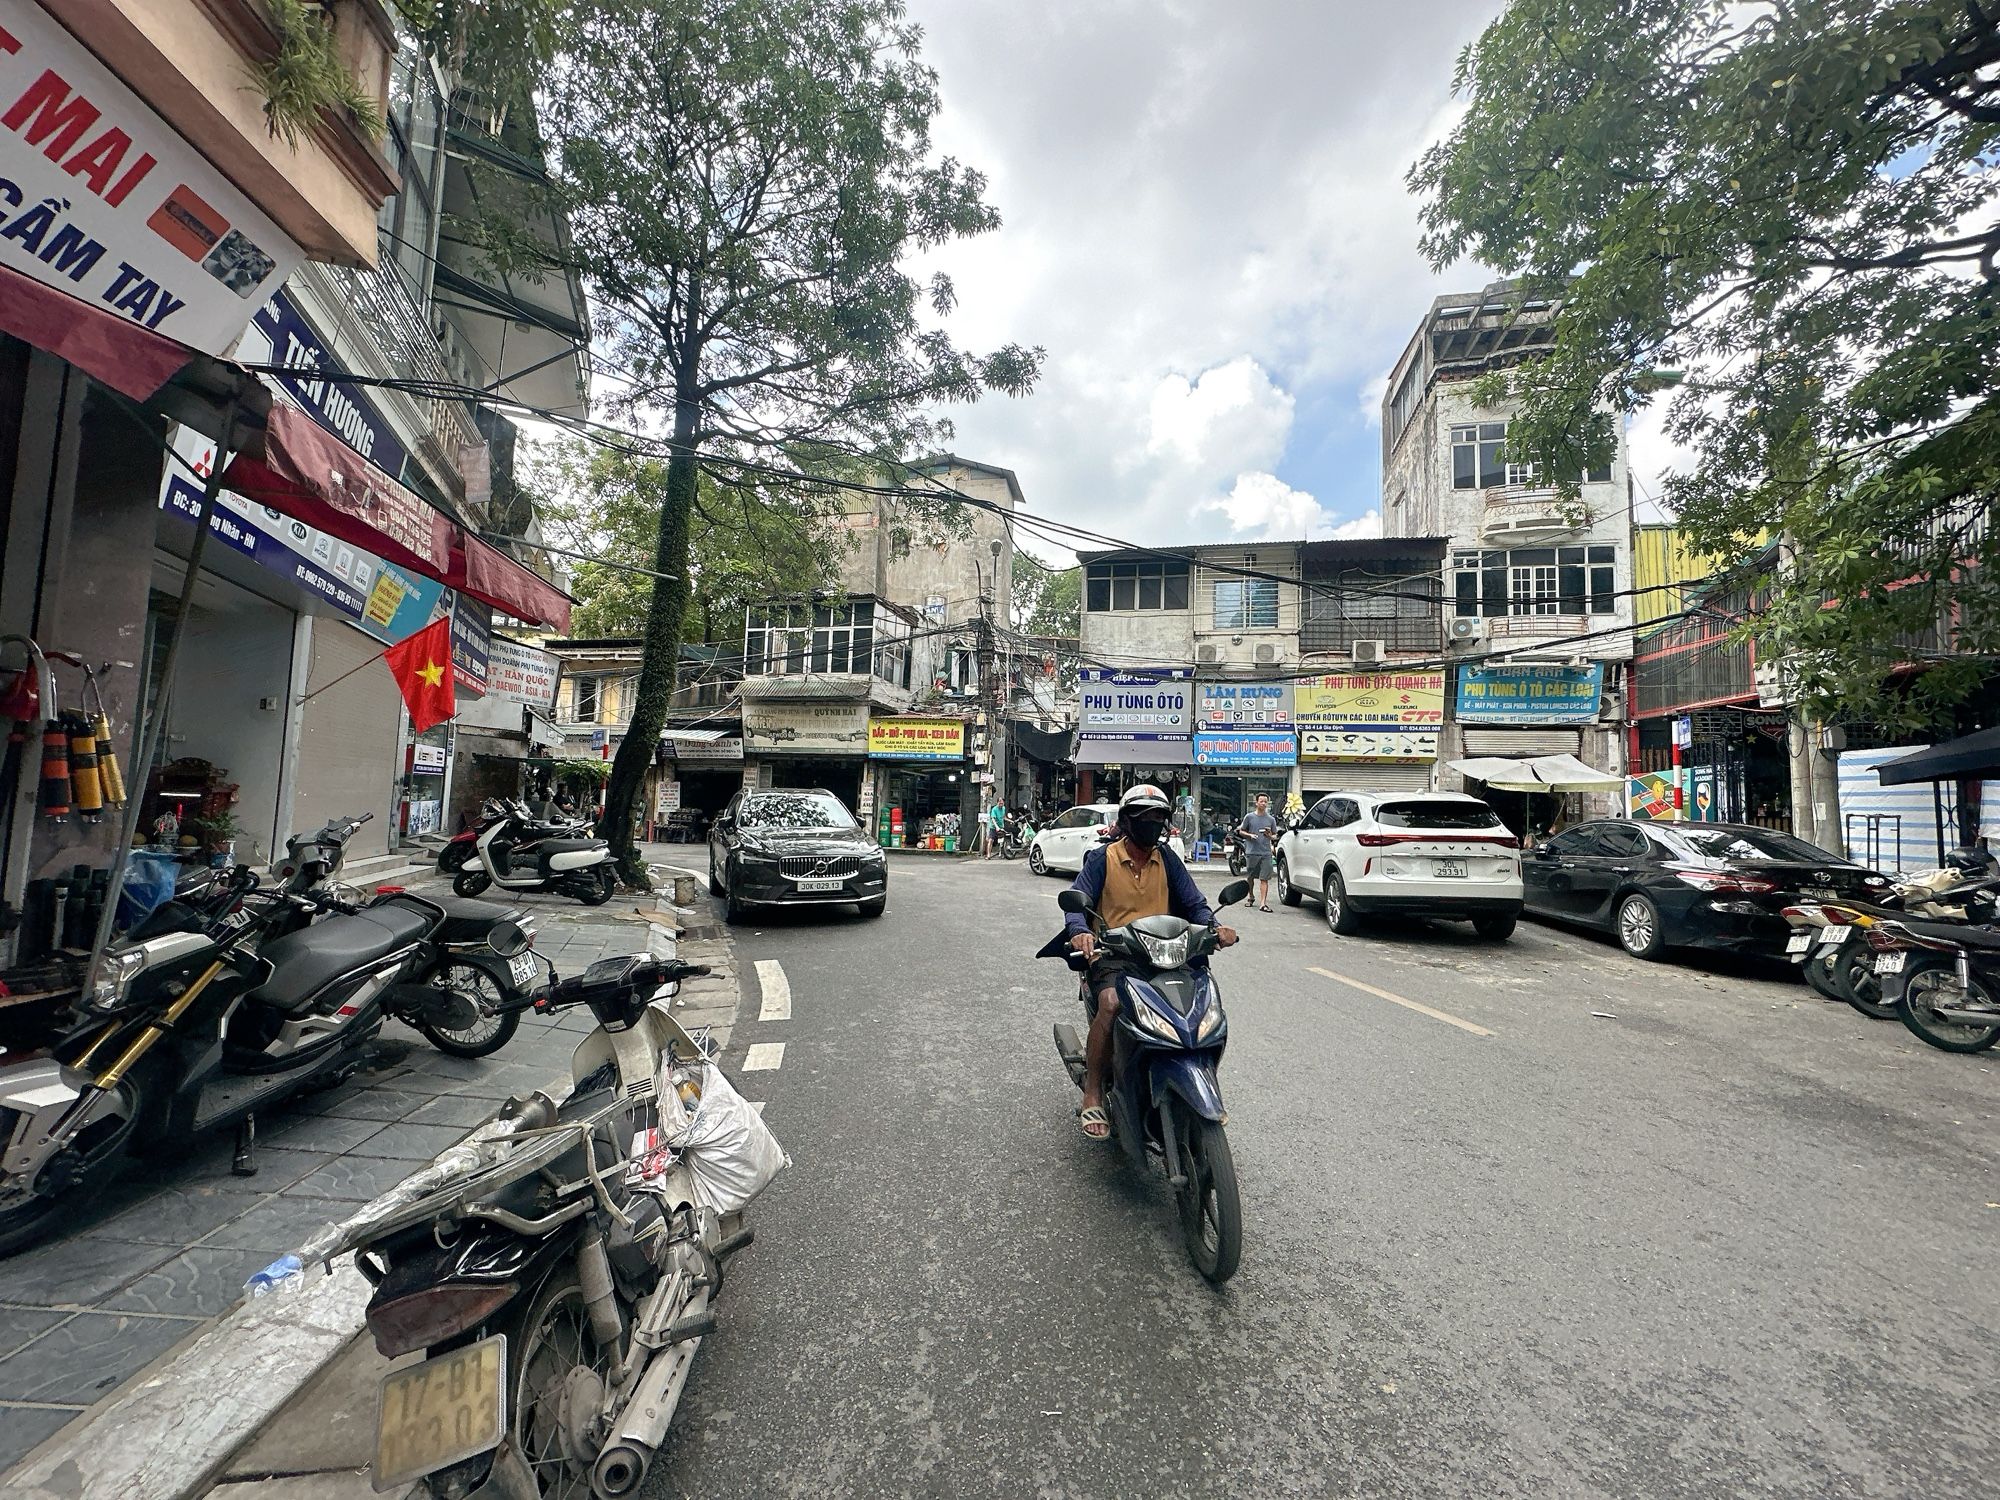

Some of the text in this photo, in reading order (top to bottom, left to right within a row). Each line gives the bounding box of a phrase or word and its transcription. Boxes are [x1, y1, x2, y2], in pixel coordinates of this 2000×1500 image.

[0, 68, 158, 208] MAI
[102, 261, 186, 329] TAY
[323, 382, 374, 459] HƯƠNG
[228, 492, 248, 510] TOYOTA
[190, 500, 202, 517] 30
[243, 532, 256, 549] HN
[293, 523, 305, 538] KIA
[496, 680, 521, 693] DAEWOO
[525, 685, 538, 696] ASIA
[525, 674, 549, 686] QUỐC
[1395, 676, 1425, 690] QUANG
[1205, 686, 1283, 698] LÂM HƯNG
[1464, 681, 1594, 699] PHỤ TÙNG Ô TÔ CÁC LOẠI
[1084, 692, 1184, 712] PHỤ TÙNG ÔTÔ
[814, 707, 841, 717] QUỲNH
[1296, 712, 1321, 721] CHUYÊN
[1349, 712, 1363, 721] CÁC
[1401, 711, 1442, 722] CTR
[1745, 714, 1786, 726] SONG
[1199, 737, 1295, 755] PHỤ TÙNG Ô TÔ TRUNG QUỐC
[1442, 860, 1457, 868] 30L
